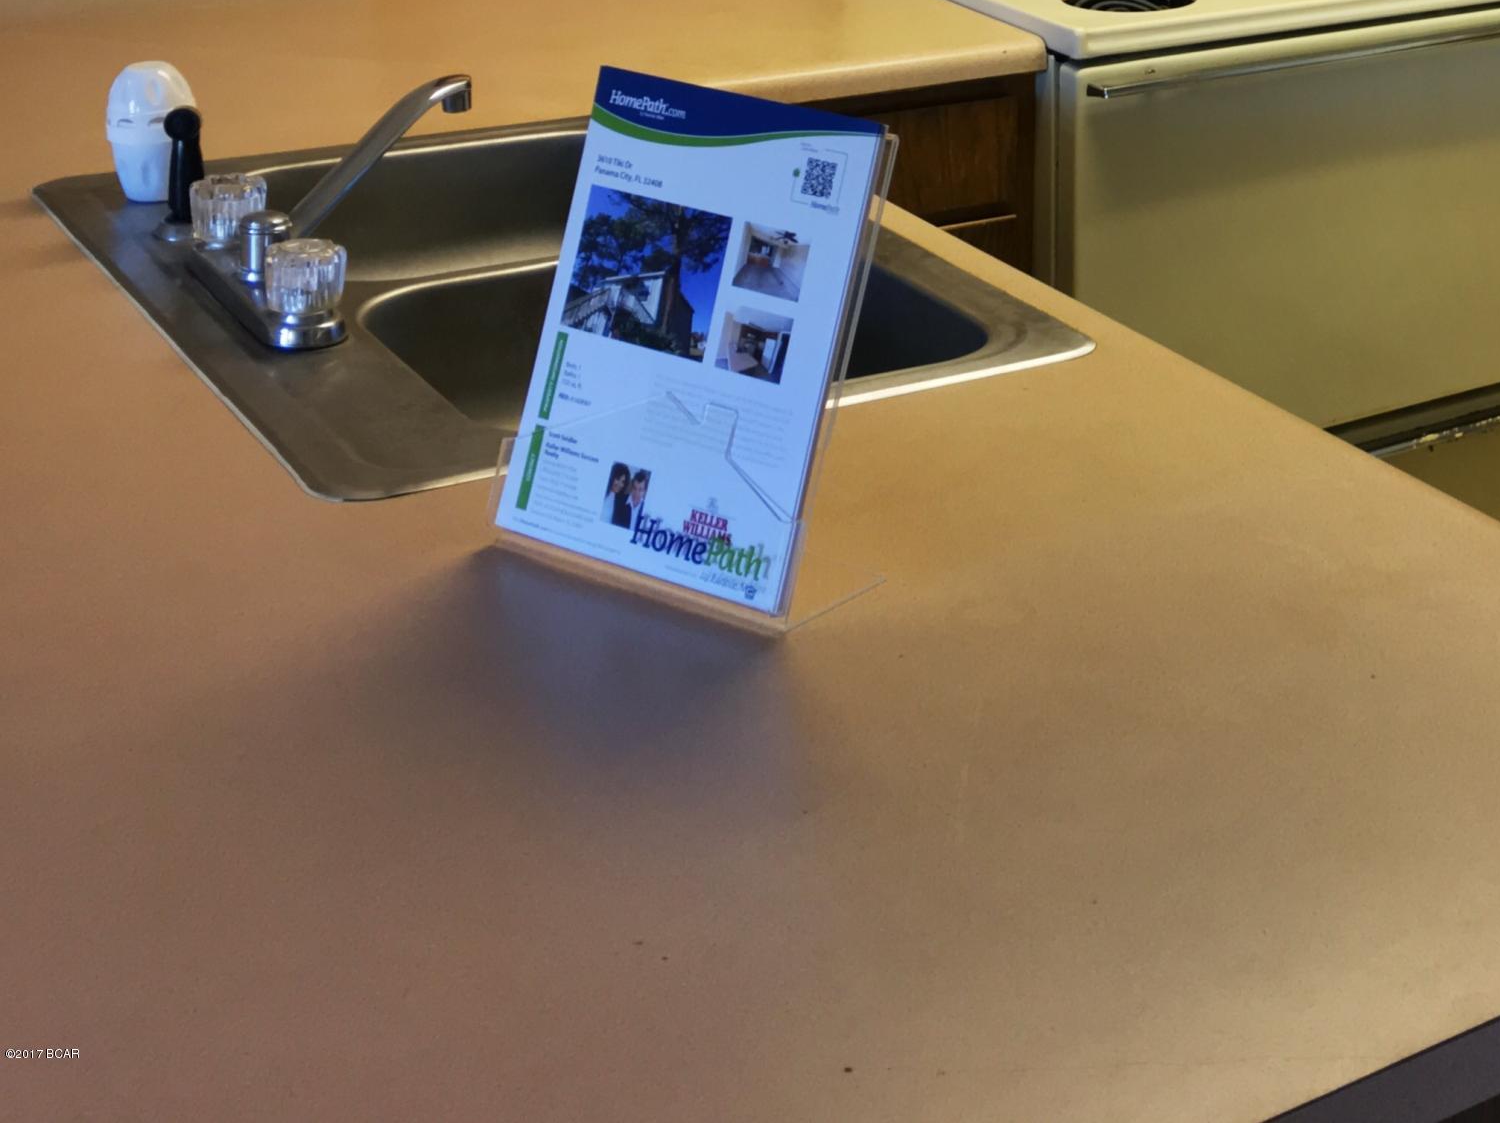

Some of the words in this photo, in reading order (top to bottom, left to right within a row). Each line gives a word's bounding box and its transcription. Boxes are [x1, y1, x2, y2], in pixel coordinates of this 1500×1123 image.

[608, 89, 687, 120] HomePath.com
[689, 509, 728, 531] KELLER
[630, 512, 764, 582] HomePath
